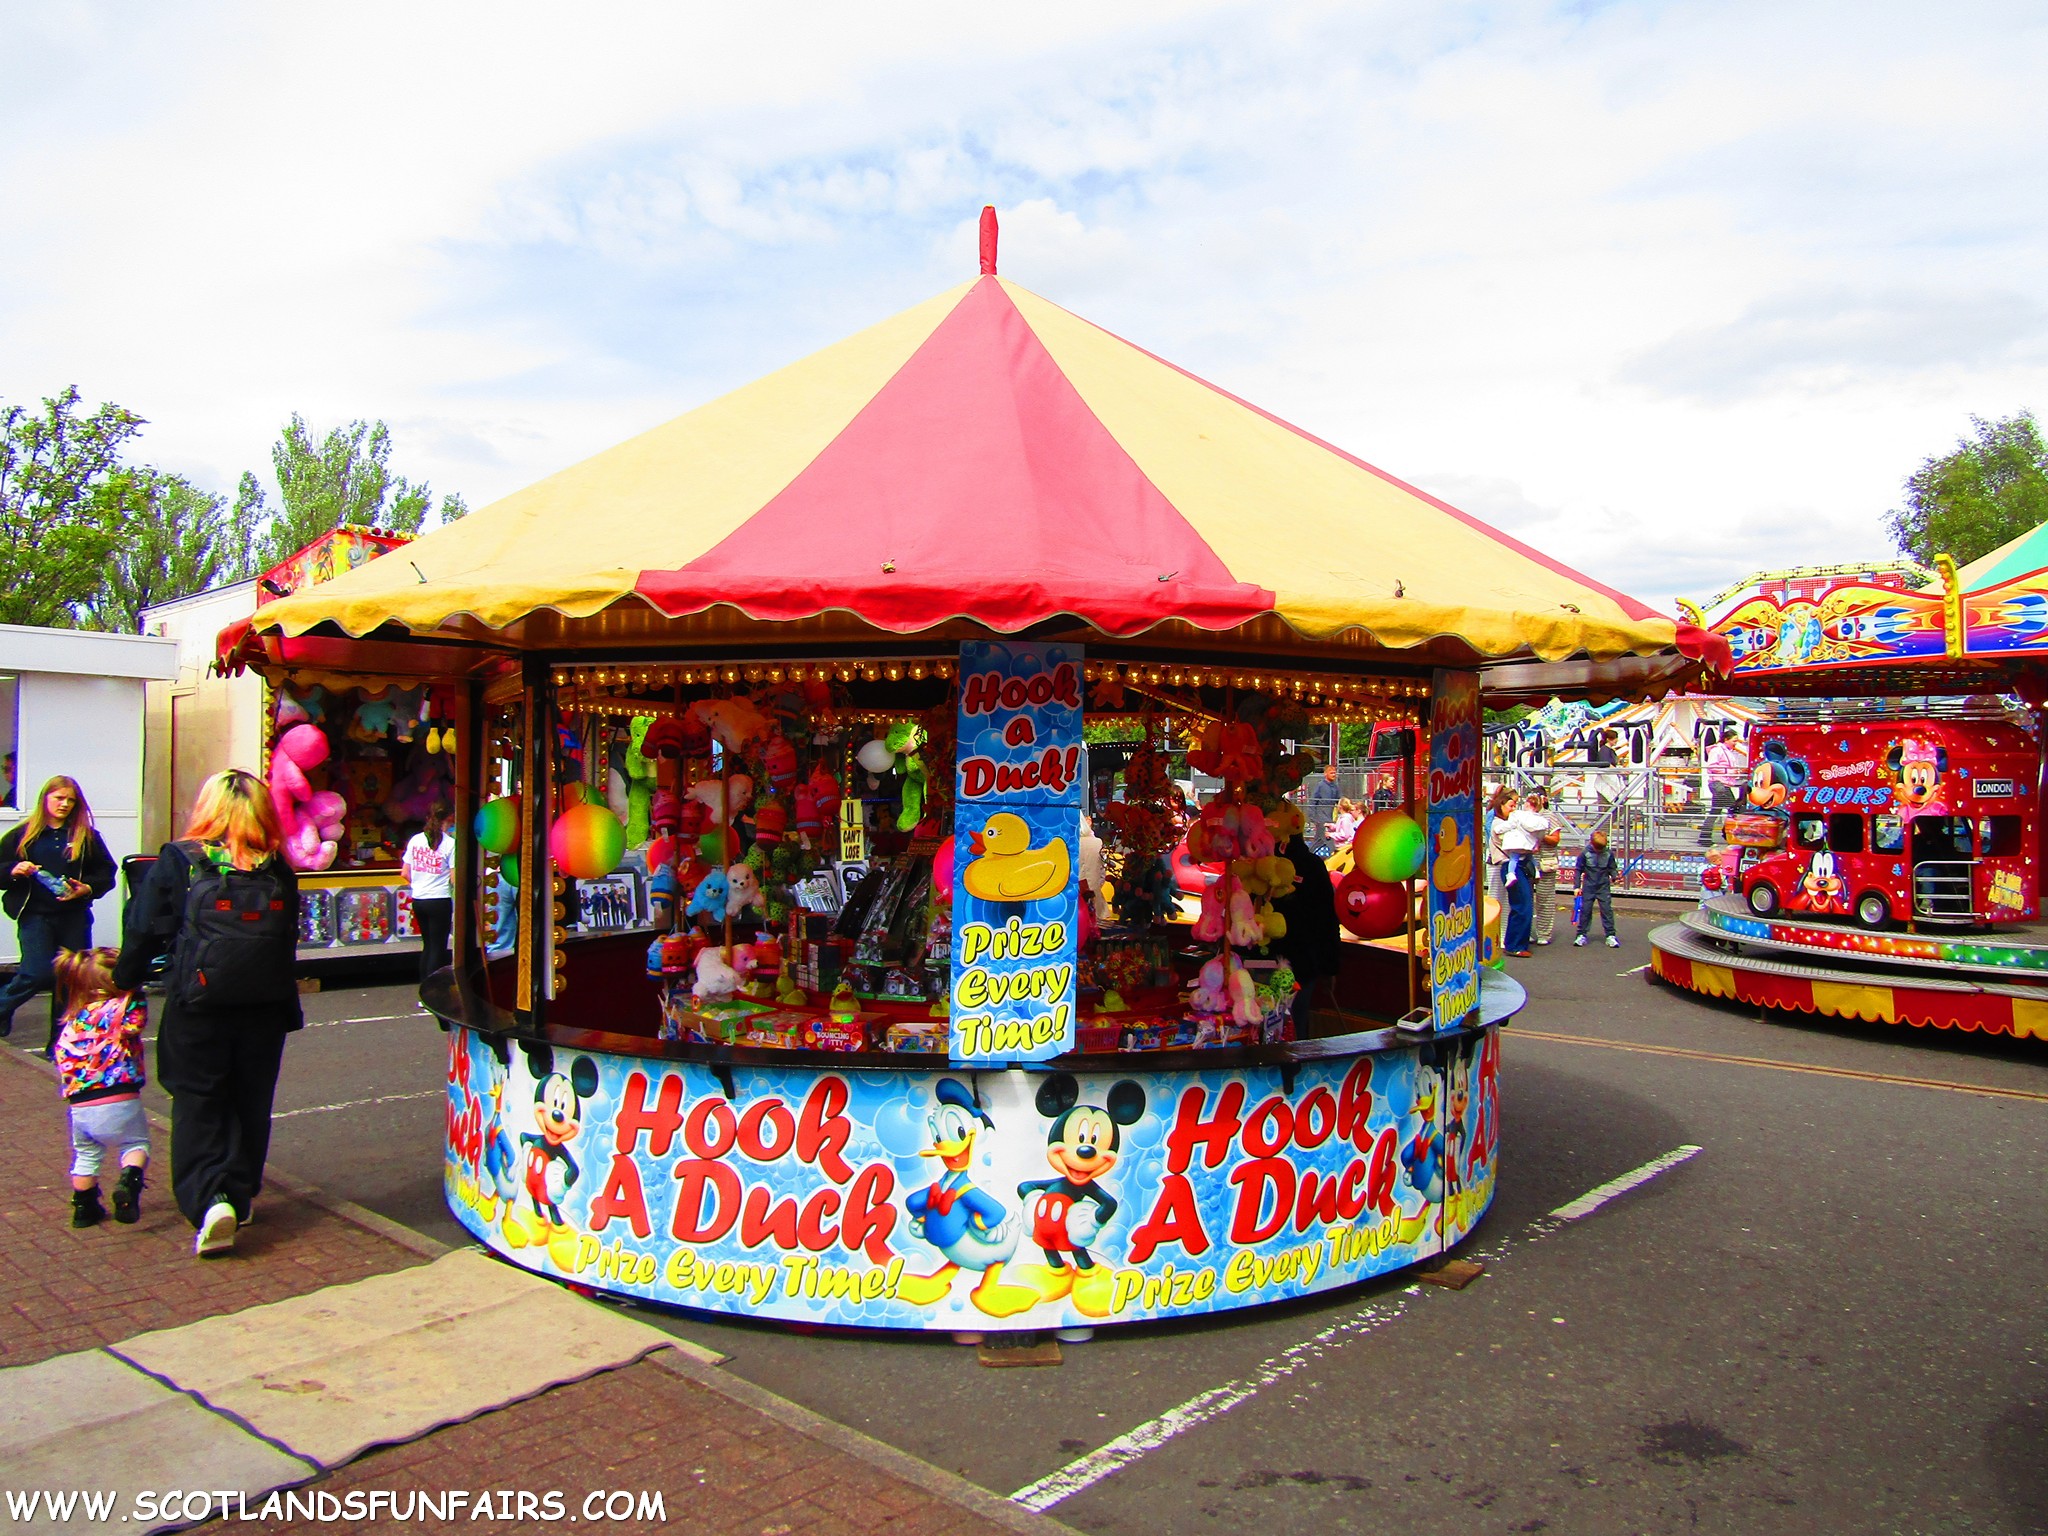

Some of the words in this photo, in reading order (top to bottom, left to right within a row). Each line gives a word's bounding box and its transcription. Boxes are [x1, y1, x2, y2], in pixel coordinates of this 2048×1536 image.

[965, 664, 1080, 714] Hook
[1434, 690, 1477, 733] Hook
[1006, 718, 1034, 746] a
[1448, 734, 1460, 760] a
[962, 747, 1079, 796] Duck!
[1431, 758, 1475, 804] Duck!
[1977, 783, 2012, 793] LONDON
[1803, 786, 1892, 805] TOURS
[844, 830, 861, 844] CAN'T
[845, 845, 860, 859] LOSE
[964, 919, 1065, 964] Prize
[1434, 904, 1472, 949] Prize
[1436, 940, 1475, 986] Every
[958, 966, 1071, 1008] Every
[1437, 972, 1477, 1027] Time!
[958, 1005, 1069, 1055] Time!
[446, 1095, 482, 1181] uck
[616, 1072, 854, 1185] Hook
[1167, 1058, 1374, 1174] Hook
[589, 1154, 652, 1238] A
[672, 1159, 898, 1268] Duck
[1128, 1175, 1210, 1264] A
[1231, 1128, 1398, 1245] Duck
[575, 1235, 657, 1285] Prize
[666, 1248, 776, 1305] Every
[783, 1252, 905, 1304] Time!
[1113, 1265, 1215, 1314] Prize
[1225, 1244, 1322, 1293] Every
[1326, 1207, 1401, 1268] Time!
